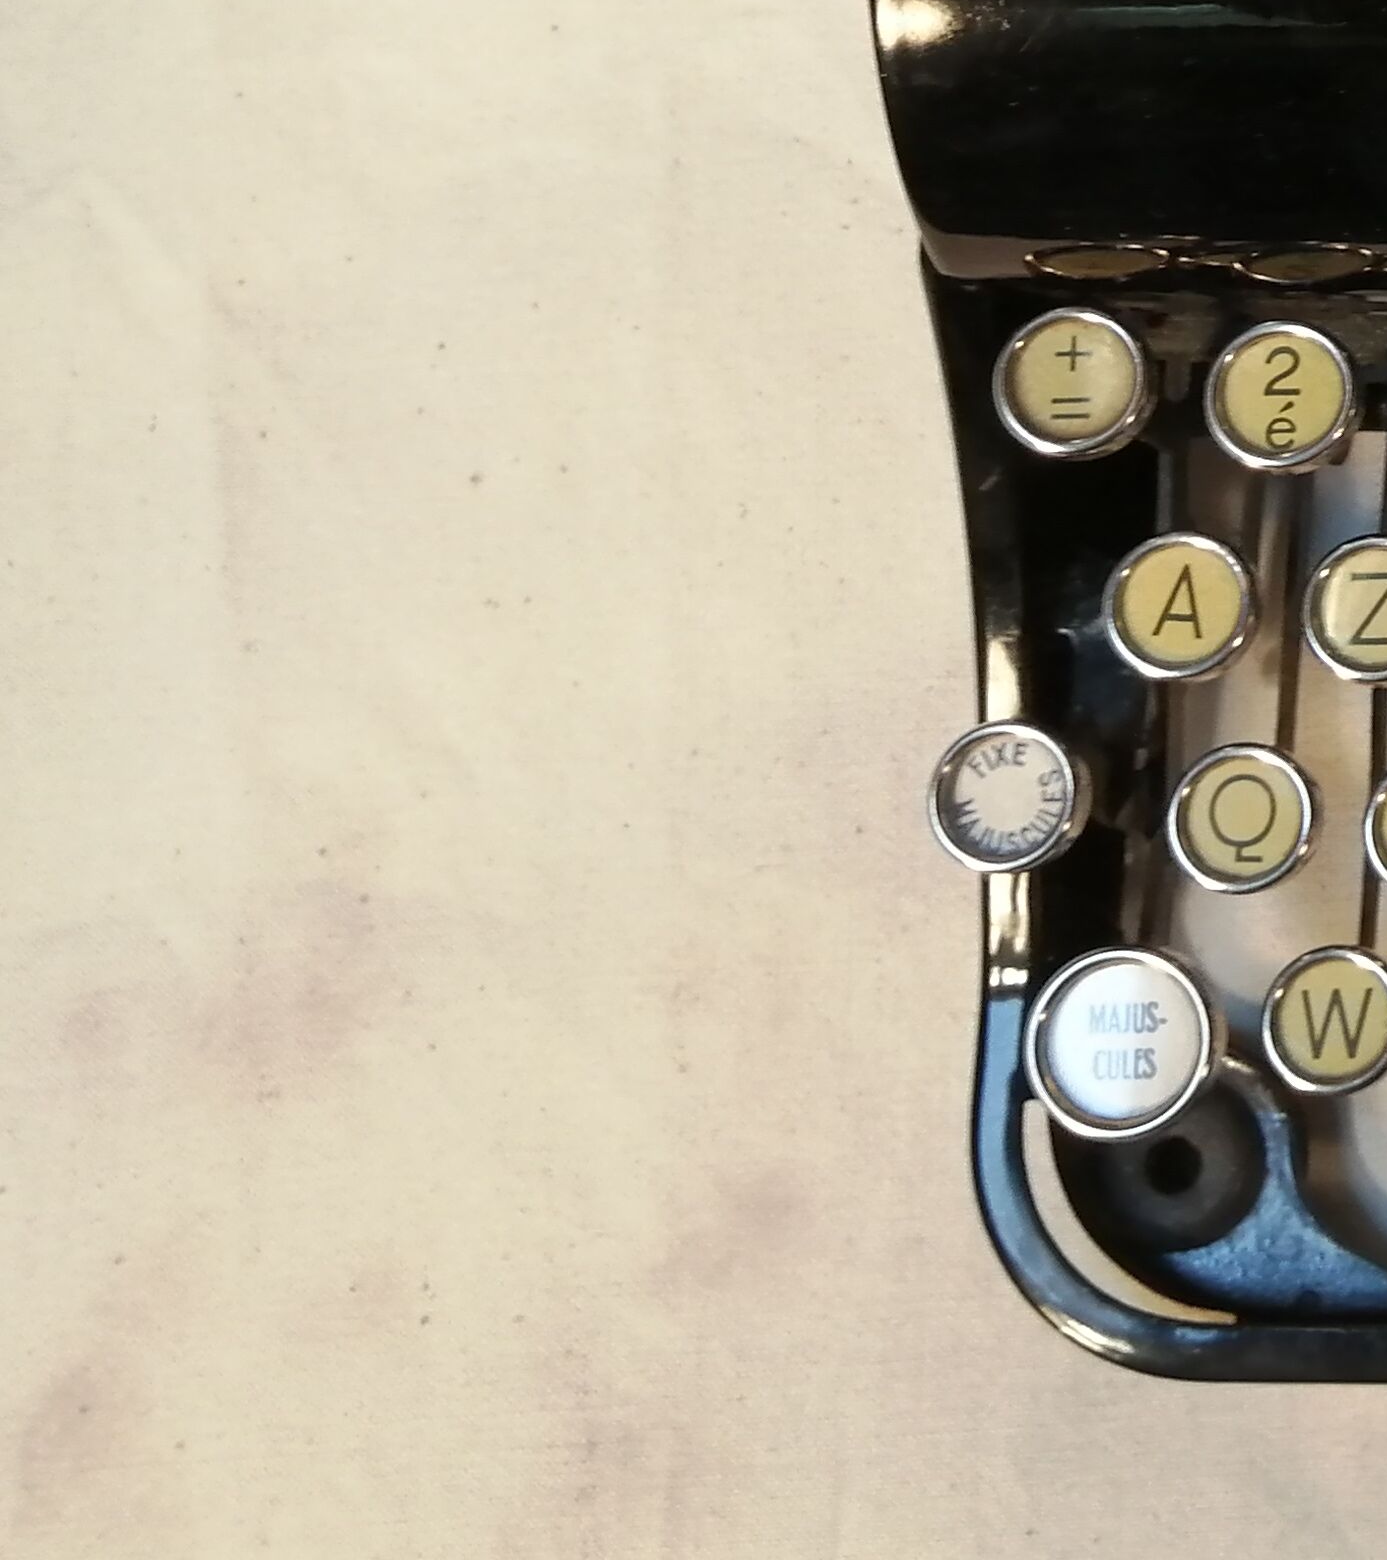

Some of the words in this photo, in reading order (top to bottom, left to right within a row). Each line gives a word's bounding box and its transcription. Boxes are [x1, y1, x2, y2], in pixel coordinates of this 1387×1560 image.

[1263, 346, 1301, 397] 2
[1265, 400, 1296, 449] é
[1151, 564, 1203, 639] A
[967, 743, 1030, 778] FIXE
[1209, 775, 1276, 862] Q
[1089, 1000, 1169, 1034] MAJUS-
[1302, 988, 1373, 1059] W
[1093, 1048, 1156, 1080] CULES
